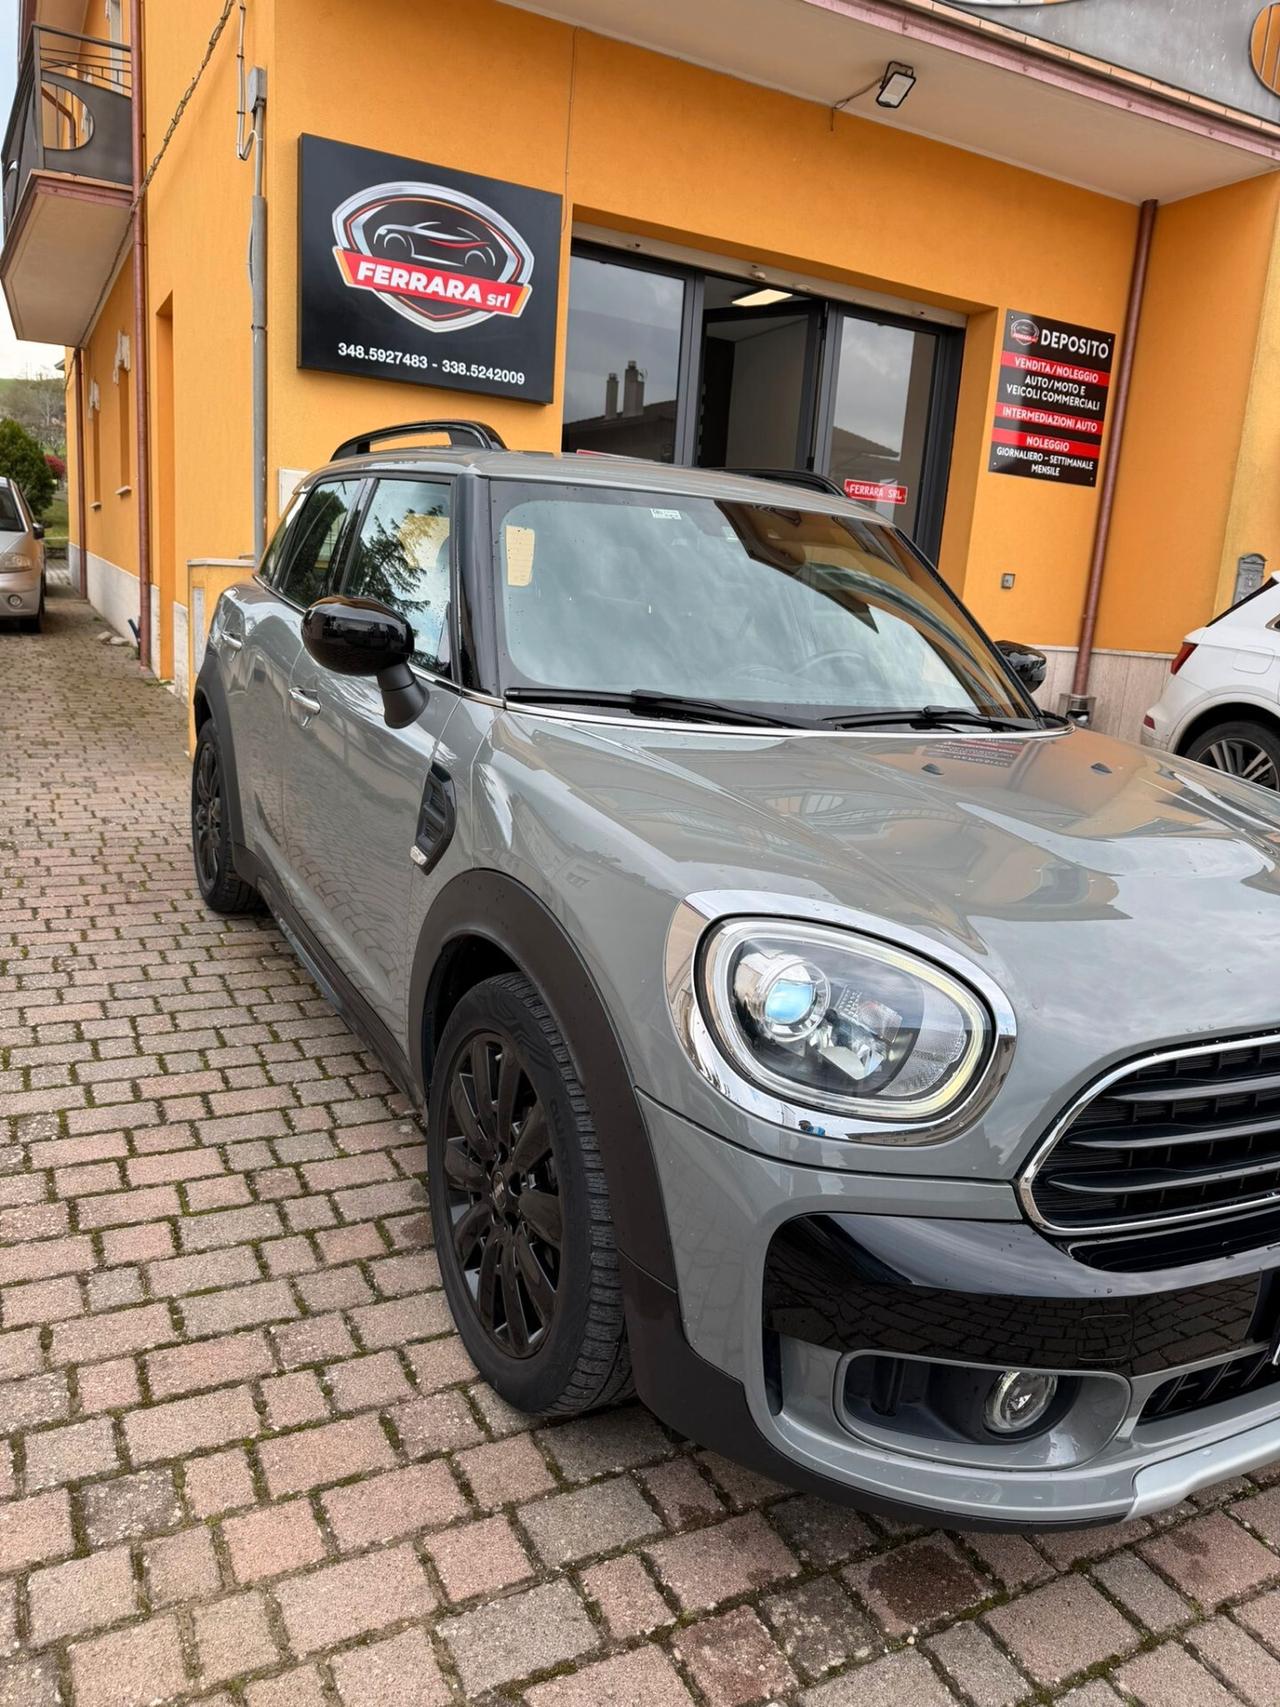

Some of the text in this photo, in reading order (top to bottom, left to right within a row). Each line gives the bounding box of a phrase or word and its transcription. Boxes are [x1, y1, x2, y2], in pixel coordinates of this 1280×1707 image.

[356, 261, 510, 308] FERRARA srl
[1041, 329, 1109, 358] DEPOSITO
[337, 342, 428, 369] 348.5927483
[442, 359, 525, 385] 338.5242009
[1014, 357, 1099, 383] VENDITA/NOLEGGIO
[1006, 384, 1100, 411] VEICOLI COMMERCIALI
[1024, 375, 1086, 396] AUTO/MOTO E
[1002, 407, 1098, 432] INTERMEDIAZIONI AUTO
[1026, 436, 1070, 452] NOLEGGIO
[996, 447, 1044, 462] GIORNALIERO
[1049, 455, 1094, 470] SETTIMANALE
[1031, 464, 1060, 476] MENSILE
[849, 484, 903, 501] FERRARA SRL
